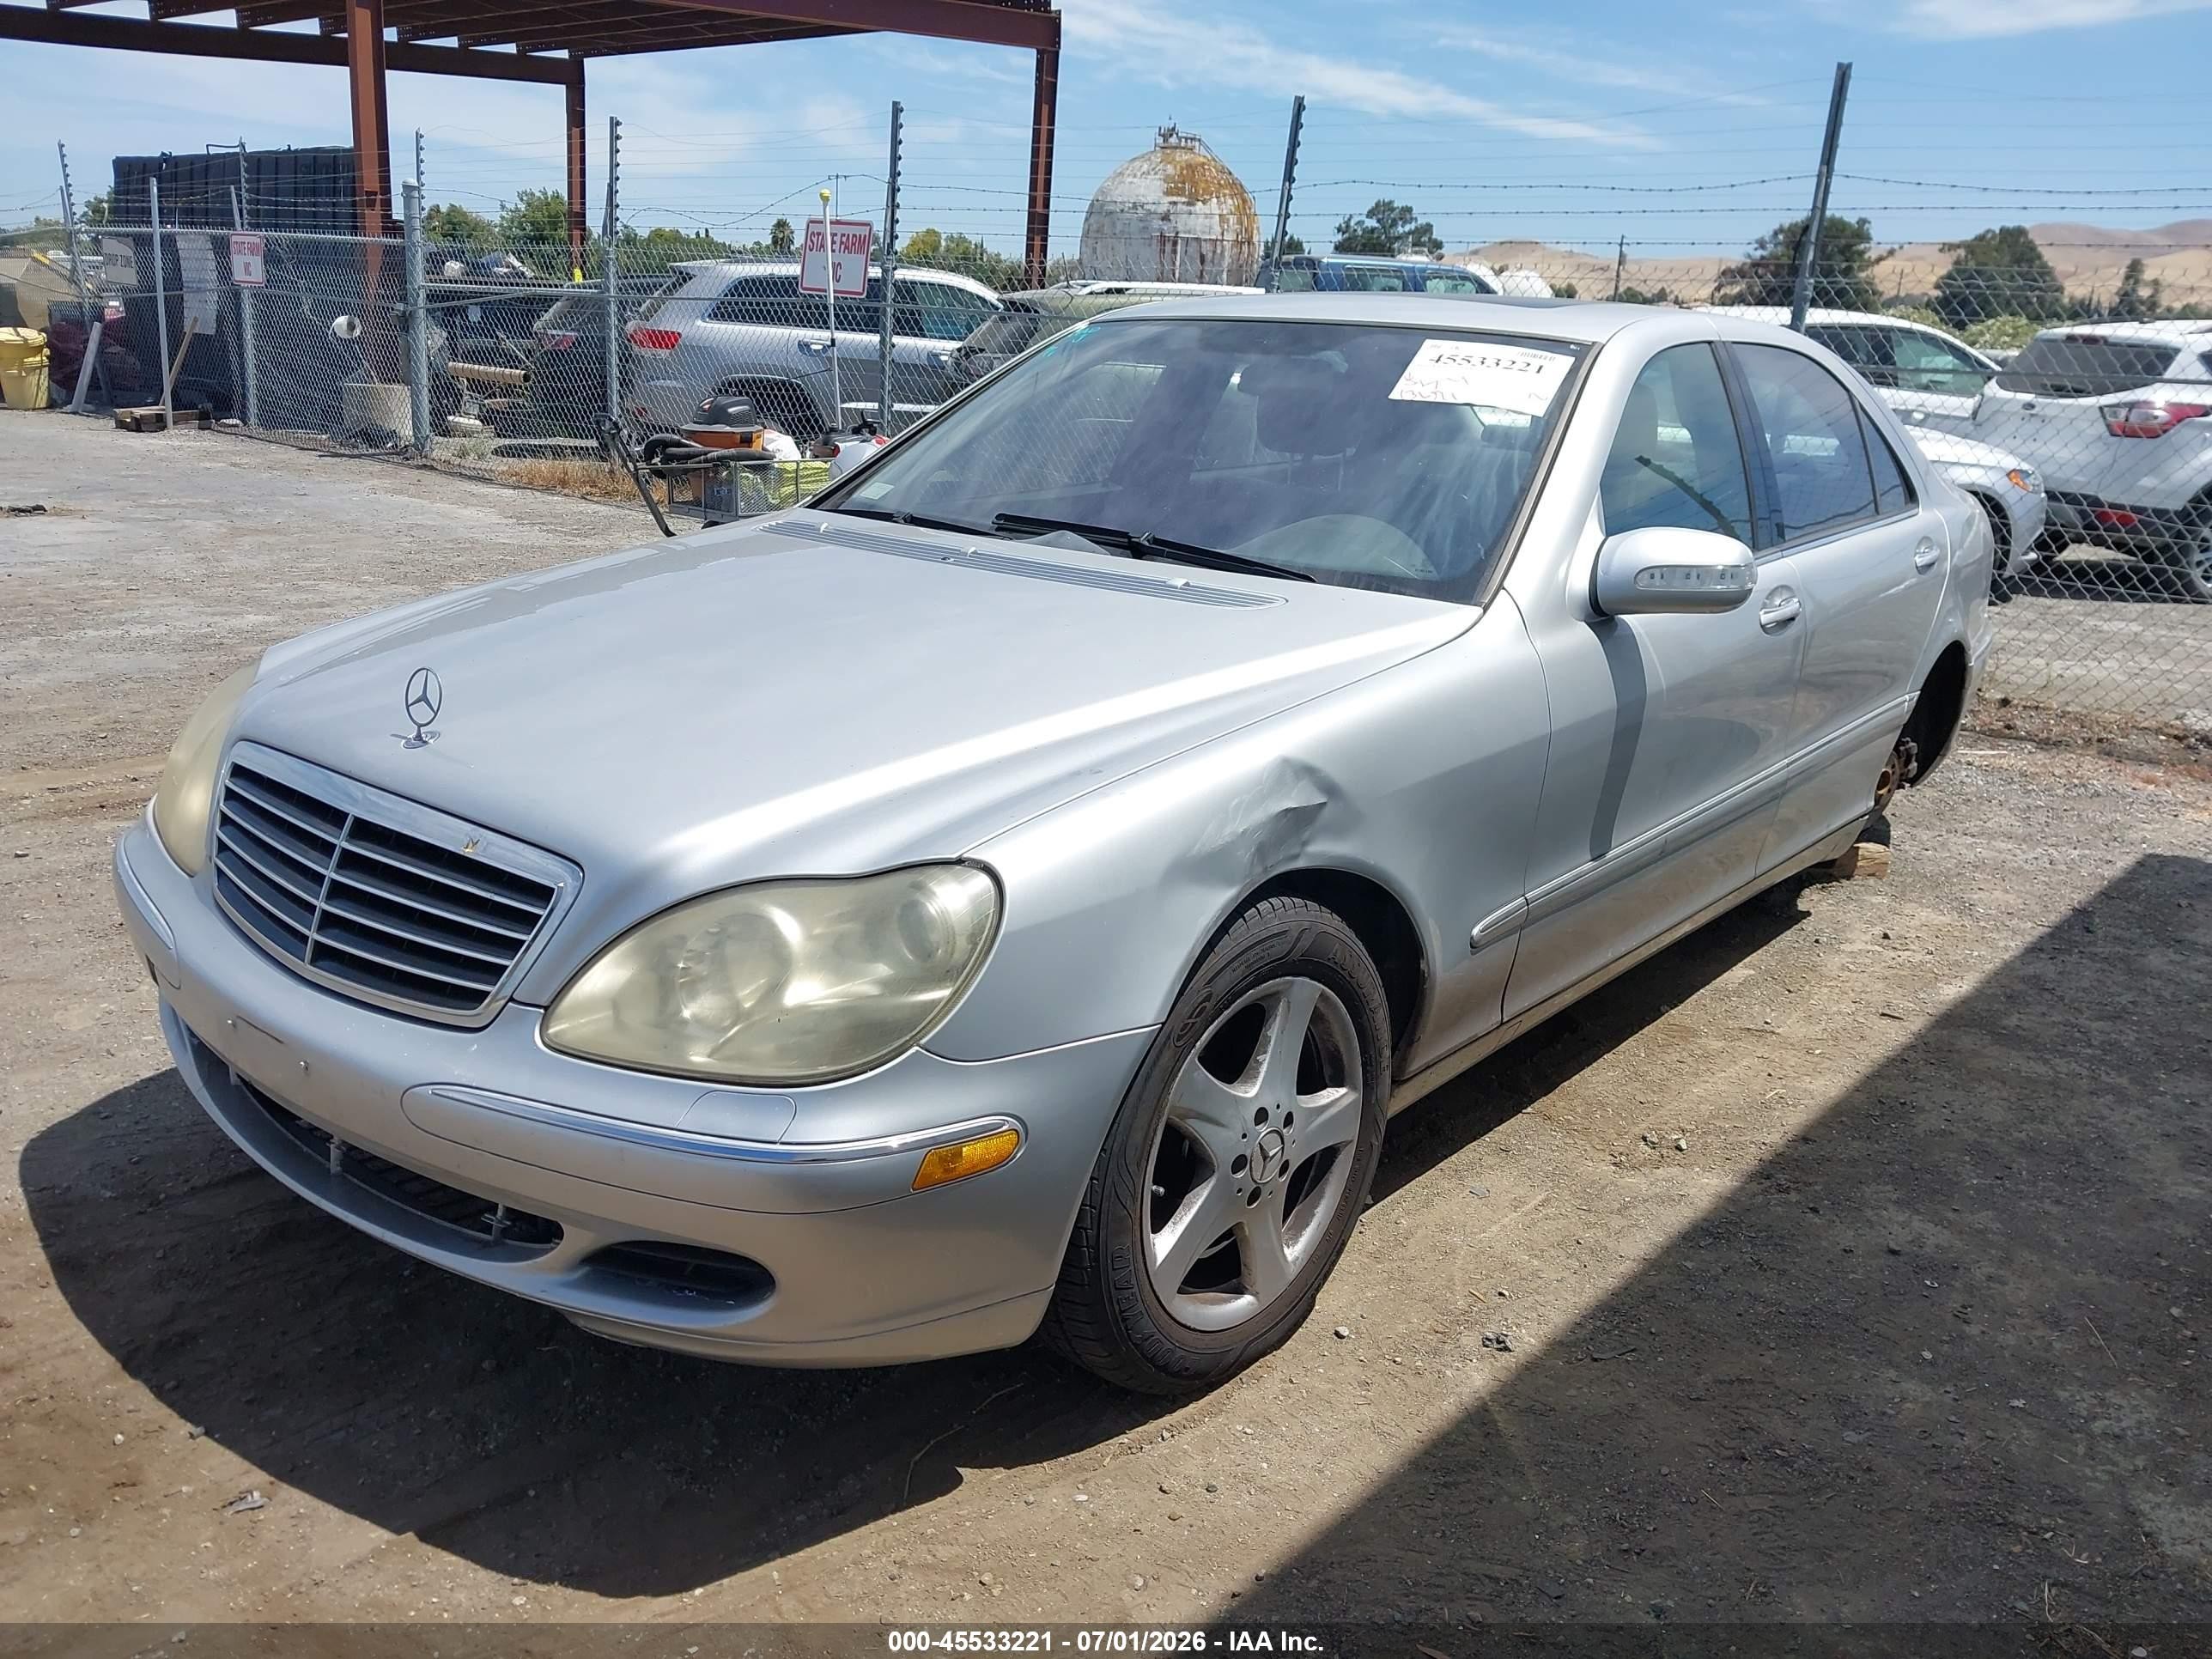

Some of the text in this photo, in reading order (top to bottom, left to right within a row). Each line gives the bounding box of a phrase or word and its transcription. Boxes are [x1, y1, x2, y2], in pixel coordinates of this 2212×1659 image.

[233, 240, 260, 257] STATE FARM
[809, 231, 866, 255] STAE FARM
[243, 261, 252, 276] VIC
[1429, 354, 1544, 374] 45533221
